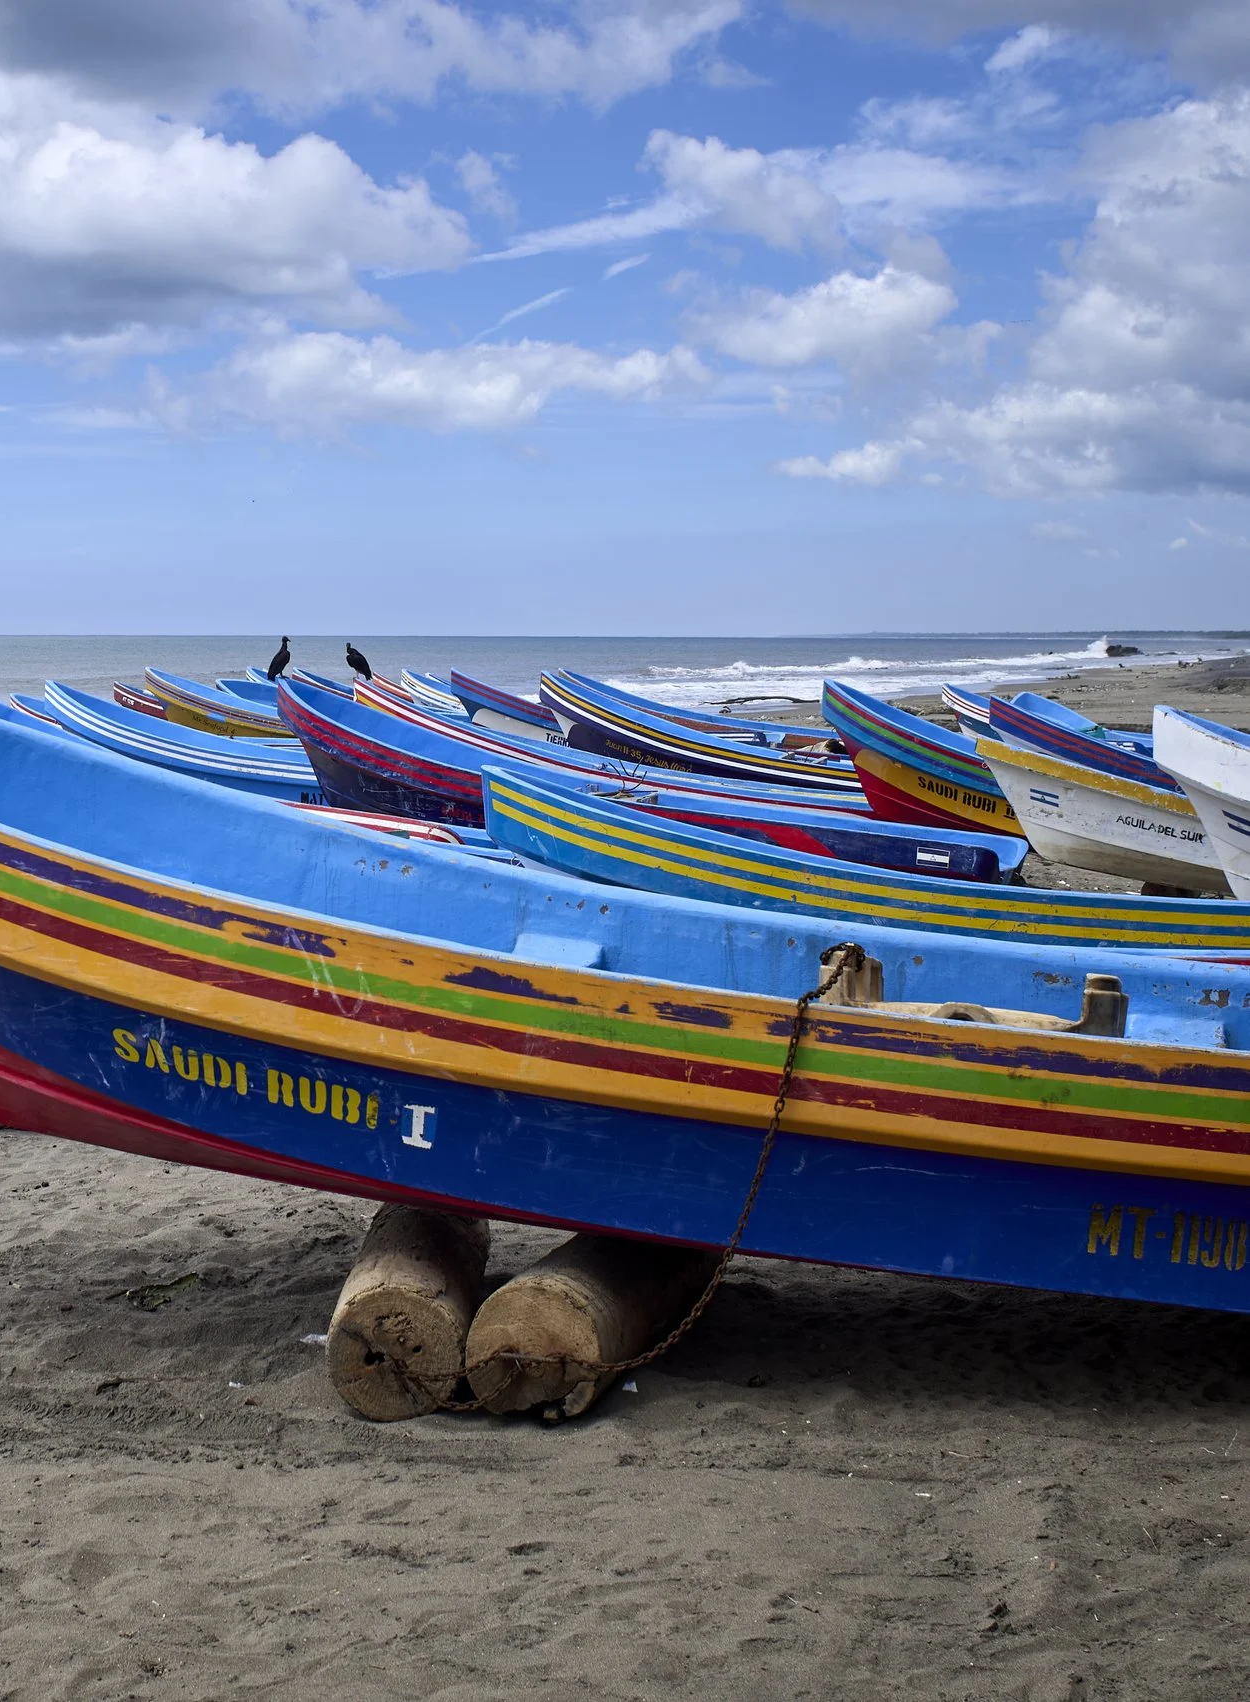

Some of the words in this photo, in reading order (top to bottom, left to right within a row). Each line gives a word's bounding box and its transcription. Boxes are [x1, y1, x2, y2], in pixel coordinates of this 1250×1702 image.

[917, 776, 958, 801] SAUDI
[962, 791, 996, 813] RUBI
[1116, 815, 1157, 832] AGUILA
[1157, 824, 1178, 838] DEL
[112, 1028, 248, 1096] SAUDI
[267, 1068, 379, 1130] RUBI
[402, 1103, 437, 1150] I
